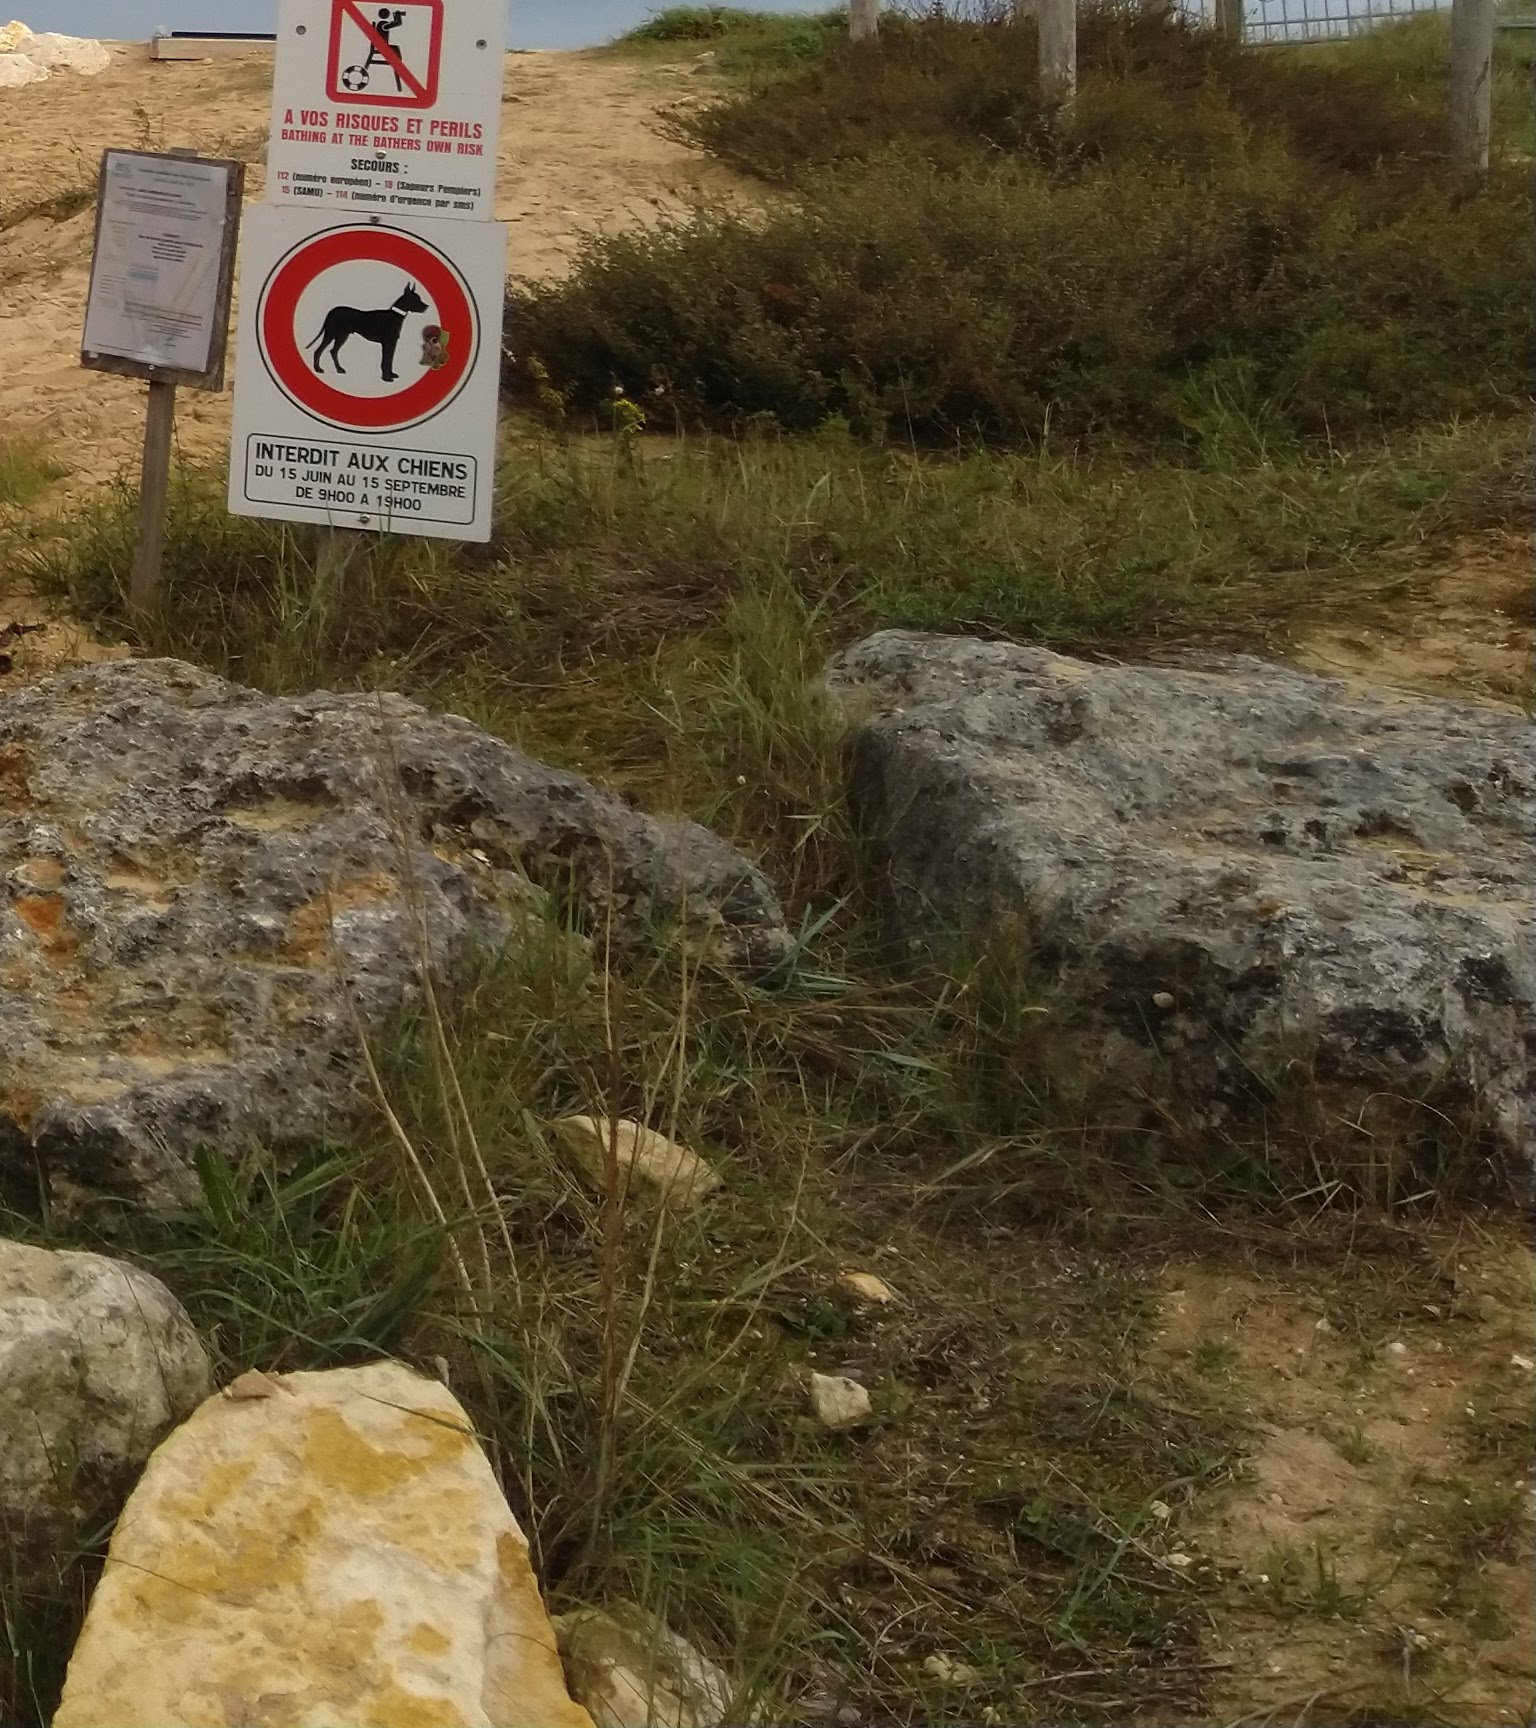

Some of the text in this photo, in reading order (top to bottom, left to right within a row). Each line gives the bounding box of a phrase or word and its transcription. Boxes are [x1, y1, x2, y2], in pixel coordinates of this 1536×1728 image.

[284, 109, 483, 139] A VOS RISQUES ET PERILS
[281, 129, 484, 157] BATHING AT THE BATHERS OWN RISK
[350, 158, 400, 174] SECOURS
[293, 186, 323, 198] (SAMU)
[256, 442, 468, 480] INTERDIT AUX CHIENS
[255, 464, 466, 498] DU 15 JUIN AU 15 SEPTEMBRE
[295, 486, 422, 511] DE 9H00 A 19H00
